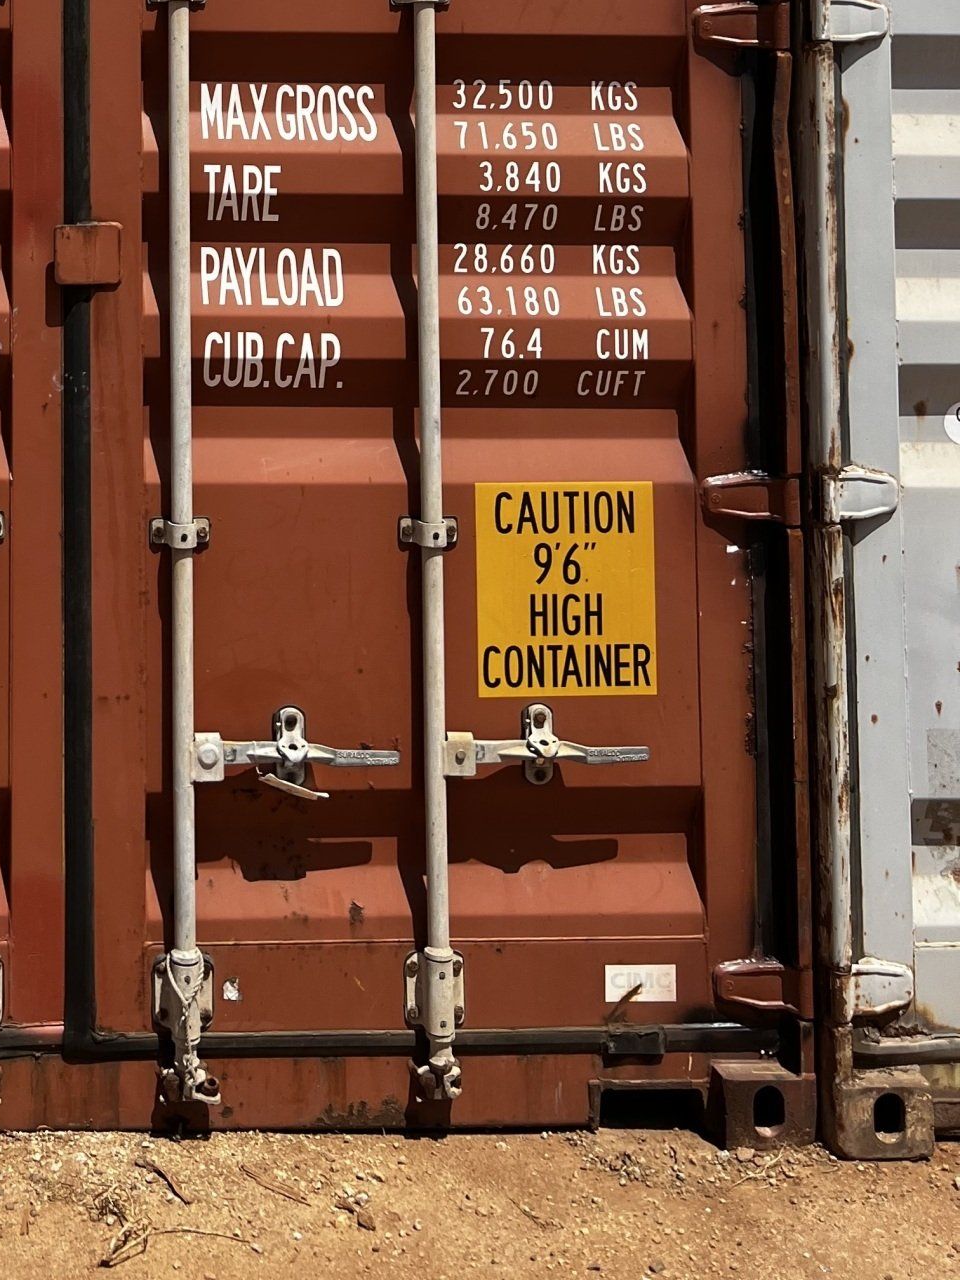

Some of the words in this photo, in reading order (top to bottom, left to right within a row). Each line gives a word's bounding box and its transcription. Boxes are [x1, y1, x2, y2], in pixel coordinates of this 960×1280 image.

[200, 82, 272, 142] MAX
[275, 83, 379, 143] GROSS
[591, 80, 638, 112] KGS
[593, 122, 645, 152] LBS
[203, 164, 282, 222] TARE
[598, 161, 648, 193] KGS
[593, 204, 644, 232] LBS
[592, 244, 640, 275] KGS
[200, 246, 344, 308] PAYLOAD
[594, 287, 647, 317] LBS
[480, 327, 543, 360] 76.4
[596, 328, 649, 361] CUM
[576, 370, 647, 397] CUFT
[494, 490, 635, 534] CAUTION
[529, 593, 603, 637] HIGH
[482, 643, 652, 688] CONTAINER
